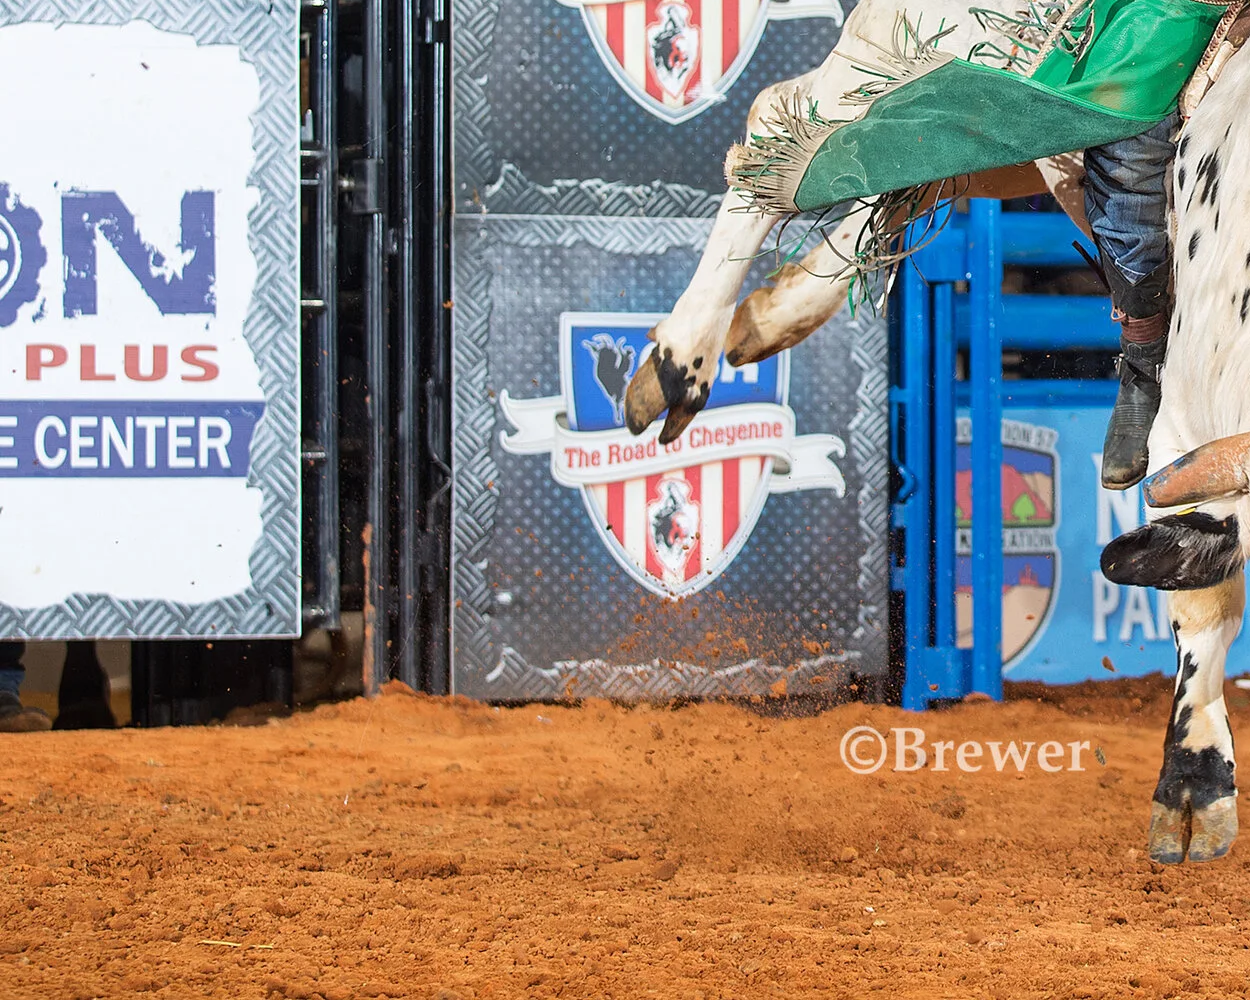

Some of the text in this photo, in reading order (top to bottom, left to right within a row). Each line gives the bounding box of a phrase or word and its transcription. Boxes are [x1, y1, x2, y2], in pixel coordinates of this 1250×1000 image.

[25, 344, 220, 382] PLUS
[34, 415, 232, 469] CENTER
[564, 447, 601, 468] The
[607, 438, 657, 465] Road
[689, 421, 783, 448] Cheyenne
